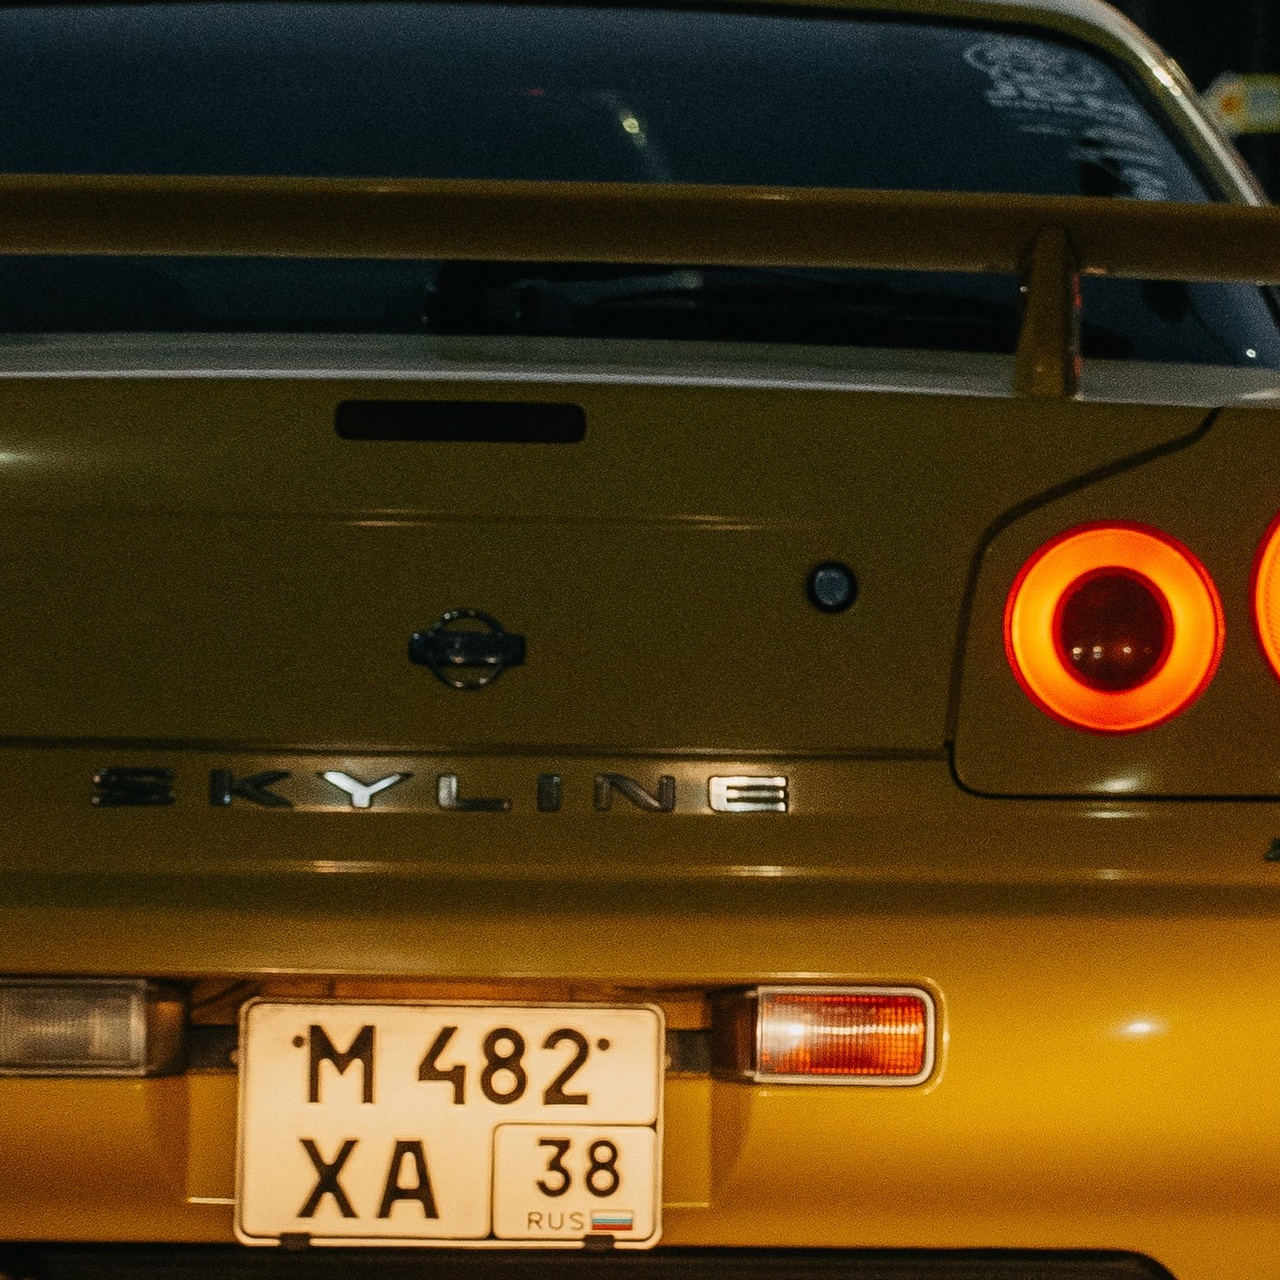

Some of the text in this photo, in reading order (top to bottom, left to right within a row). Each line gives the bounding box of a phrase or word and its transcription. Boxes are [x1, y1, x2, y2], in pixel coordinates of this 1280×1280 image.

[92, 768, 790, 813] SKYLINE
[417, 1026, 589, 1106] 482
[536, 1138, 621, 1197] 38
[528, 1211, 584, 1230] RUS
